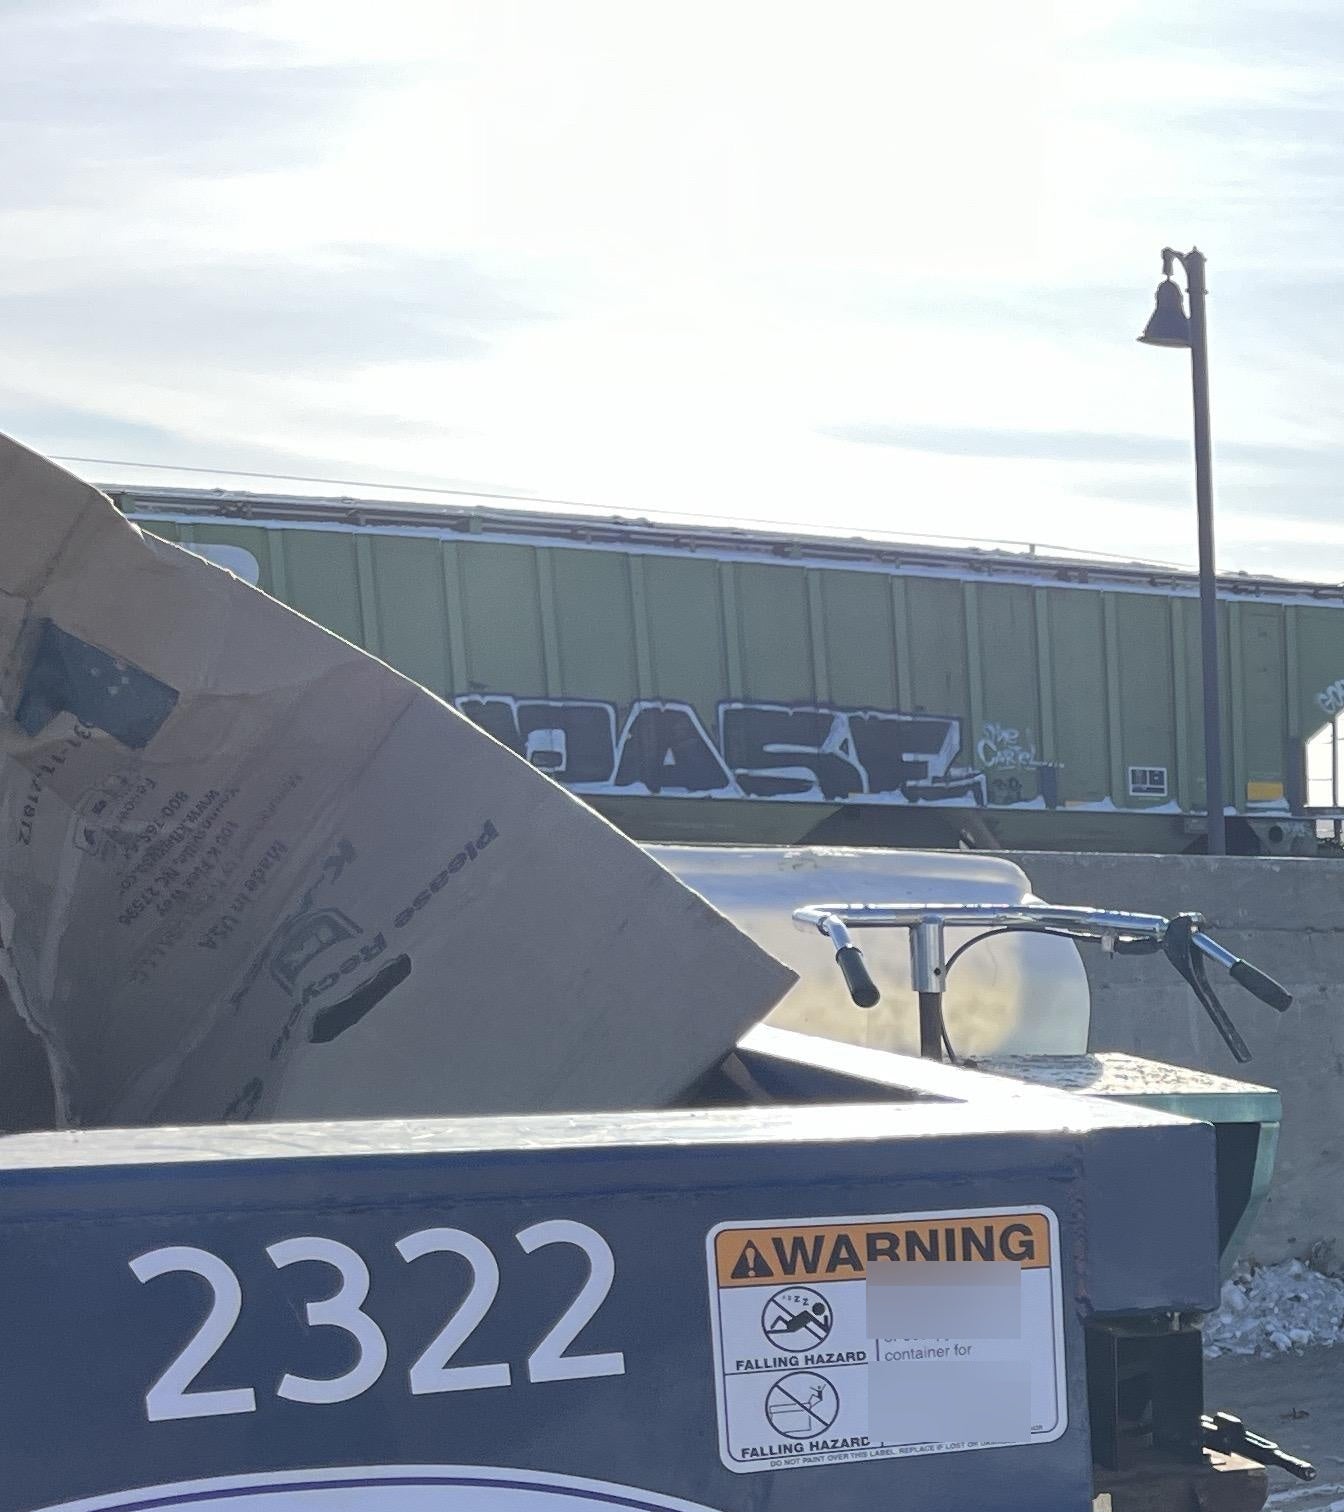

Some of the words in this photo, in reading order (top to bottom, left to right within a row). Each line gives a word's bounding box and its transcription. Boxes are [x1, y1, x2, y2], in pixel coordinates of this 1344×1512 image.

[771, 1223, 1036, 1277] WARNING
[128, 1220, 626, 1422] 2322
[736, 1355, 799, 1371] FALLING
[804, 1351, 867, 1366] HAZARD
[884, 1345, 952, 1362] container
[953, 1343, 973, 1356] for
[741, 1442, 804, 1459] FALLING
[809, 1436, 871, 1450] HAZARD
